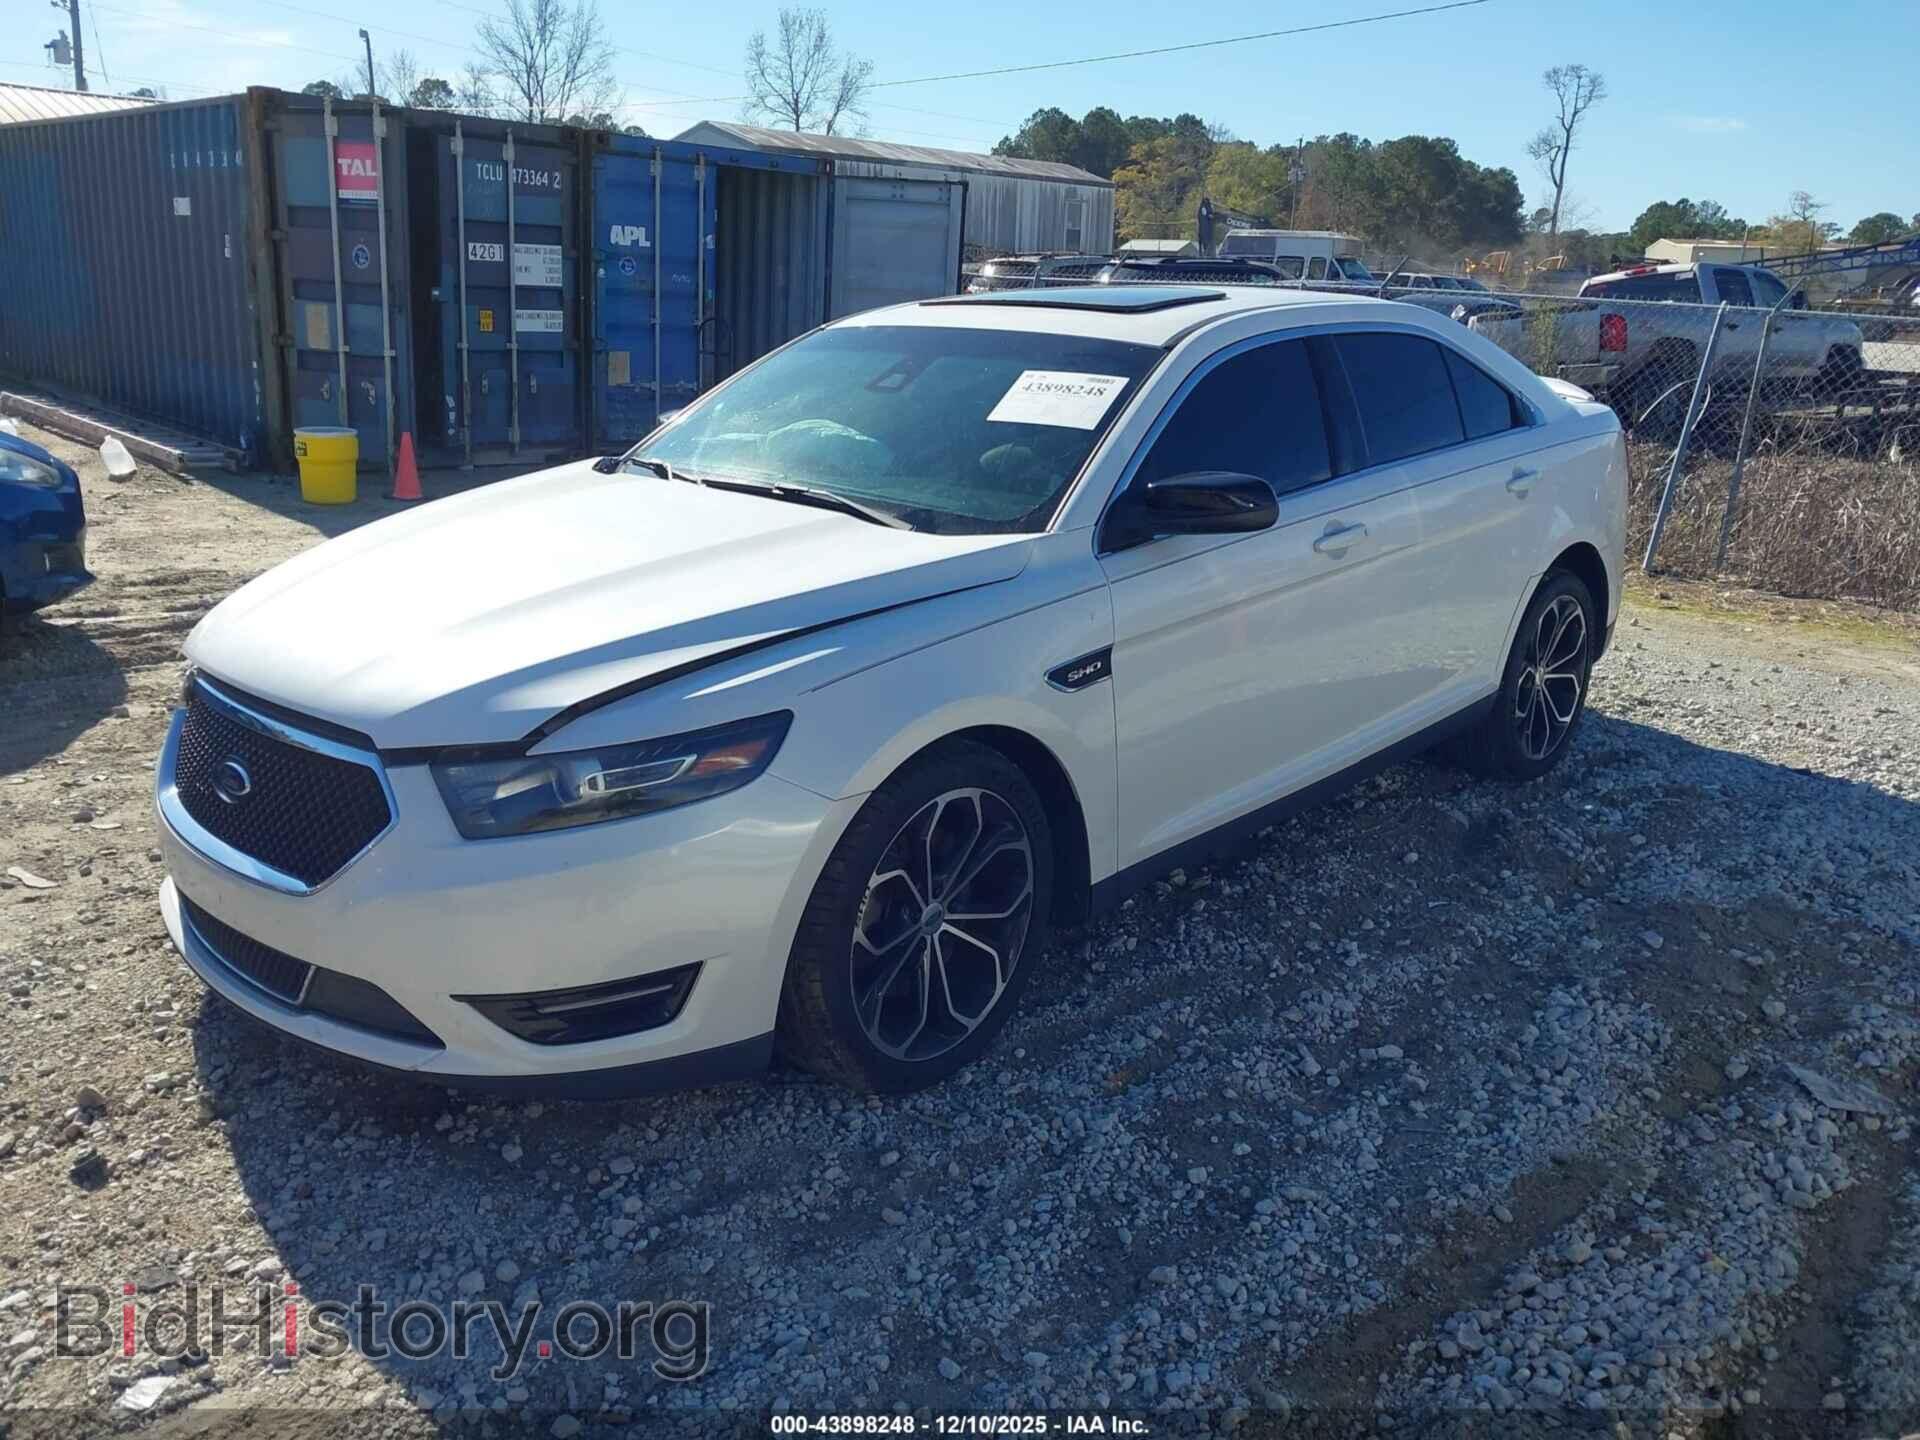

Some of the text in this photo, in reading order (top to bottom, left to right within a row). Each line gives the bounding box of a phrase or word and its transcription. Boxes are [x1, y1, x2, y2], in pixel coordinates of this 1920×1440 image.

[337, 158, 377, 176] TAL
[476, 163, 503, 181] TCLU
[553, 172, 561, 188] 2
[610, 225, 651, 247] APL
[470, 245, 503, 260] 42G1
[1022, 382, 1108, 396] 43898248
[1067, 661, 1102, 682] SHO
